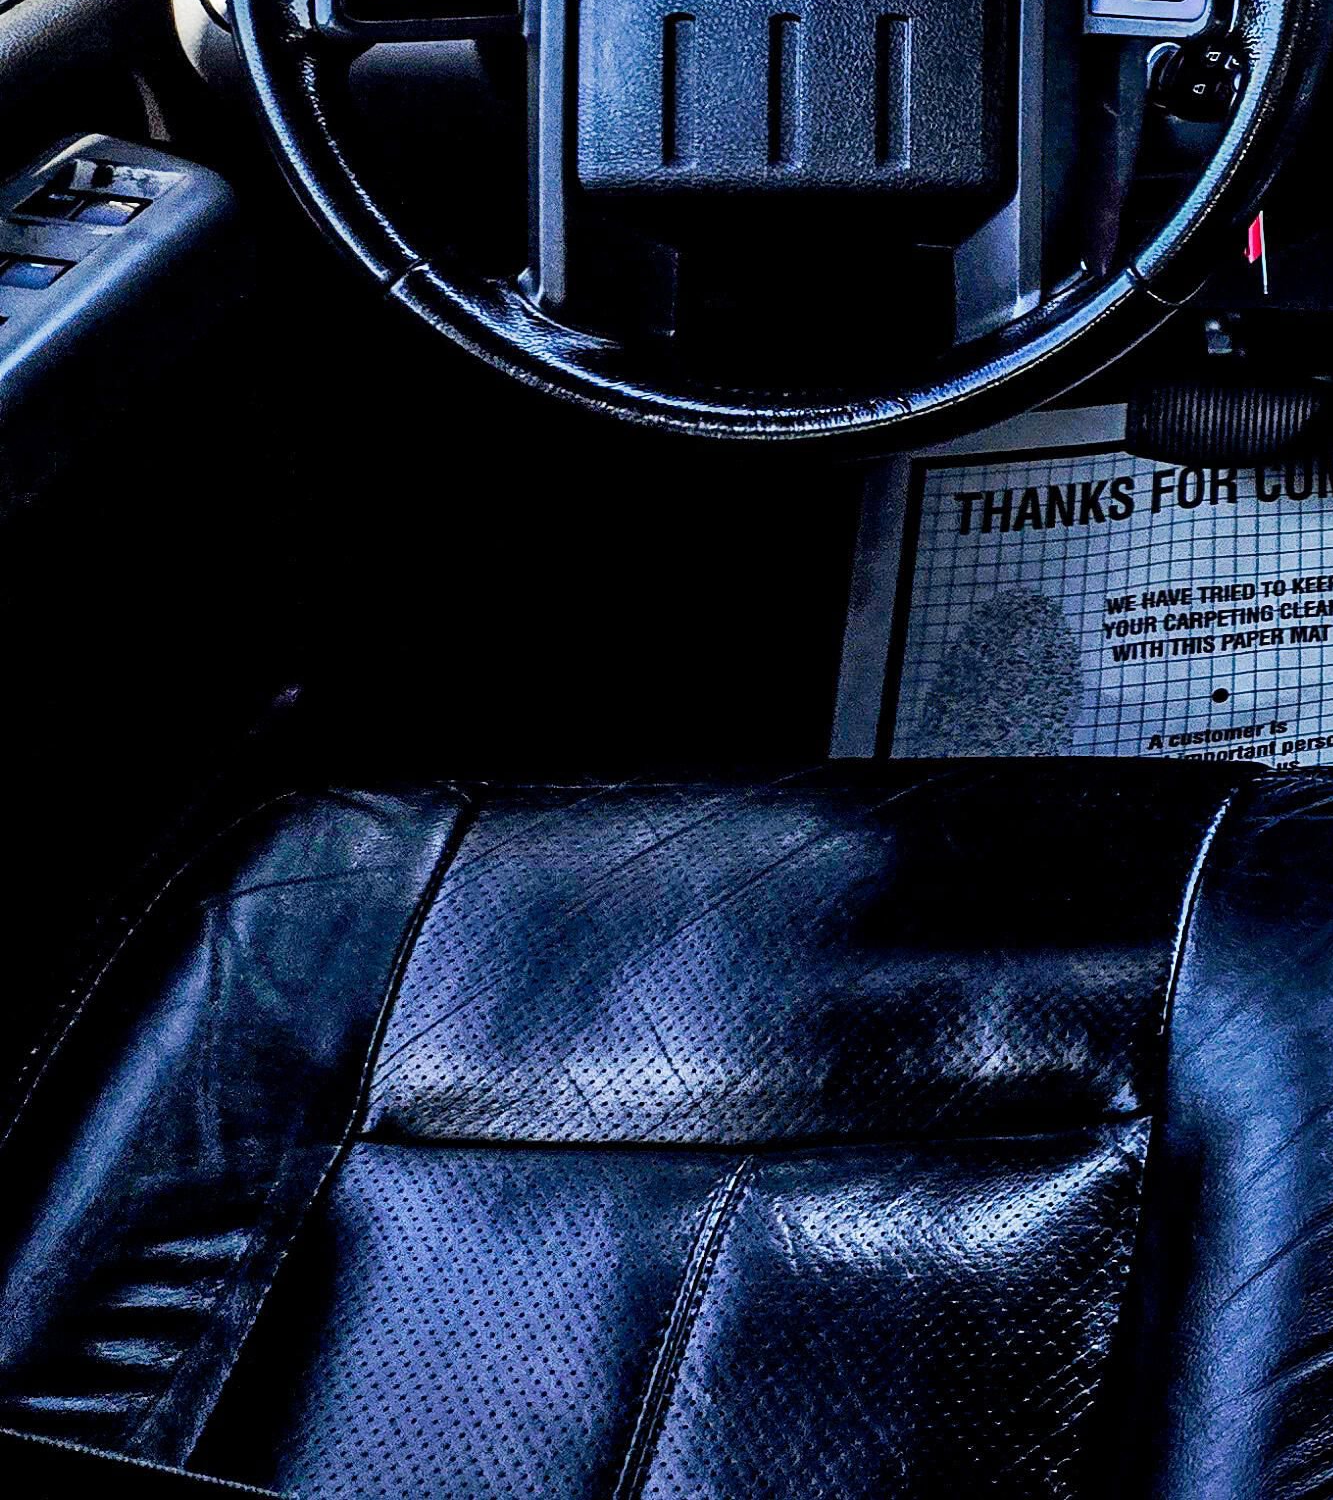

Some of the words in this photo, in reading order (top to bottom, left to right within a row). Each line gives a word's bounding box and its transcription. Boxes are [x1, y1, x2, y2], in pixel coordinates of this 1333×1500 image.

[954, 475, 1135, 536] THANKS
[1151, 464, 1238, 514] FOR
[1105, 594, 1137, 615] WE
[1141, 587, 1193, 609] HAVE
[1197, 583, 1256, 604] TRIED
[1260, 579, 1286, 597] TO
[1102, 615, 1157, 640] YOUR
[1163, 605, 1274, 632] CARPETING
[1112, 639, 1164, 663] WITH
[1169, 635, 1216, 657] THIS
[1220, 627, 1284, 652] PAPER
[1289, 624, 1332, 644] MAT
[1148, 734, 1164, 750] A
[1168, 723, 1266, 748] customer
[1268, 719, 1288, 735] is
